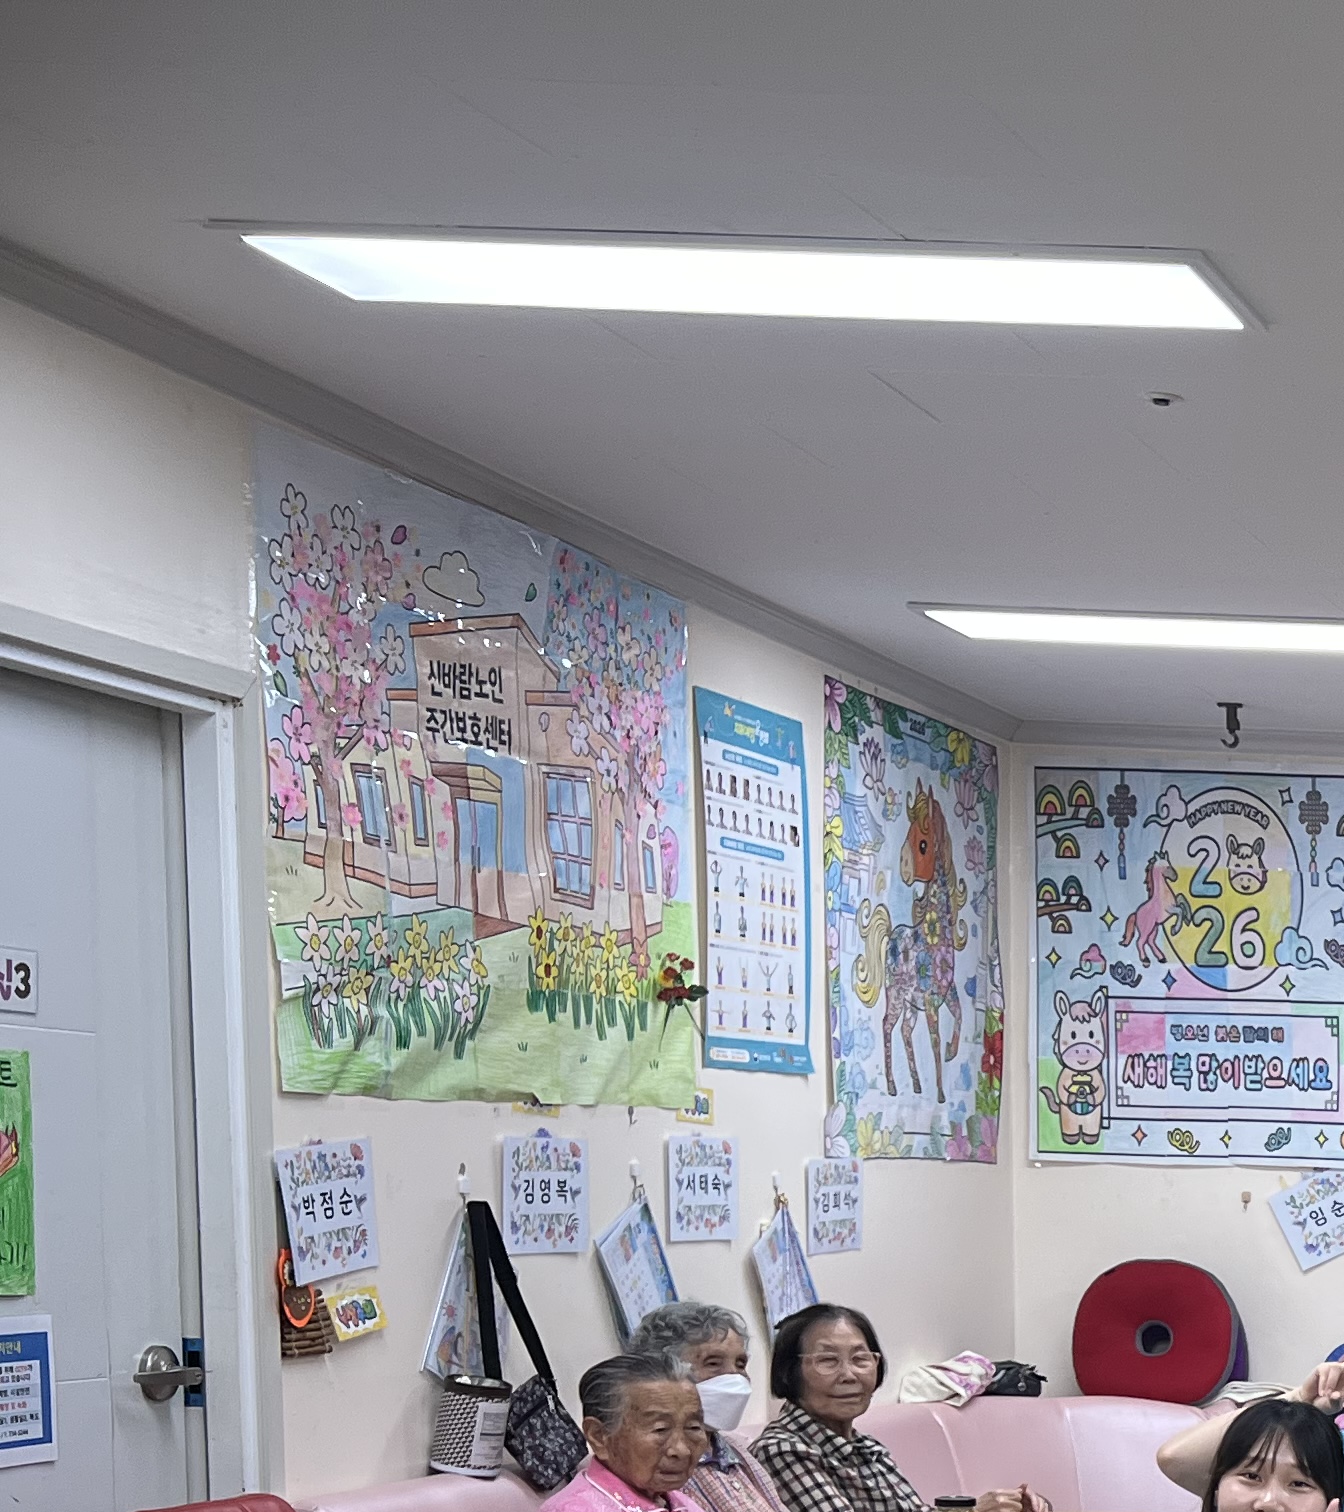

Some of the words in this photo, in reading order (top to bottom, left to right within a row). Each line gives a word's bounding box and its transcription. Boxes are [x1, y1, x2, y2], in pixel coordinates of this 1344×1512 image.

[428, 660, 504, 704] 신바람노인
[425, 706, 512, 755] 주간보호센터
[1186, 801, 1220, 829] HAPPY
[1220, 800, 1244, 815] NEW
[1242, 803, 1270, 830] YEAR
[1123, 1053, 1167, 1089] 새해
[1170, 1053, 1193, 1091] 복
[301, 1187, 353, 1223] 박점순
[523, 1179, 569, 1204] 김영복
